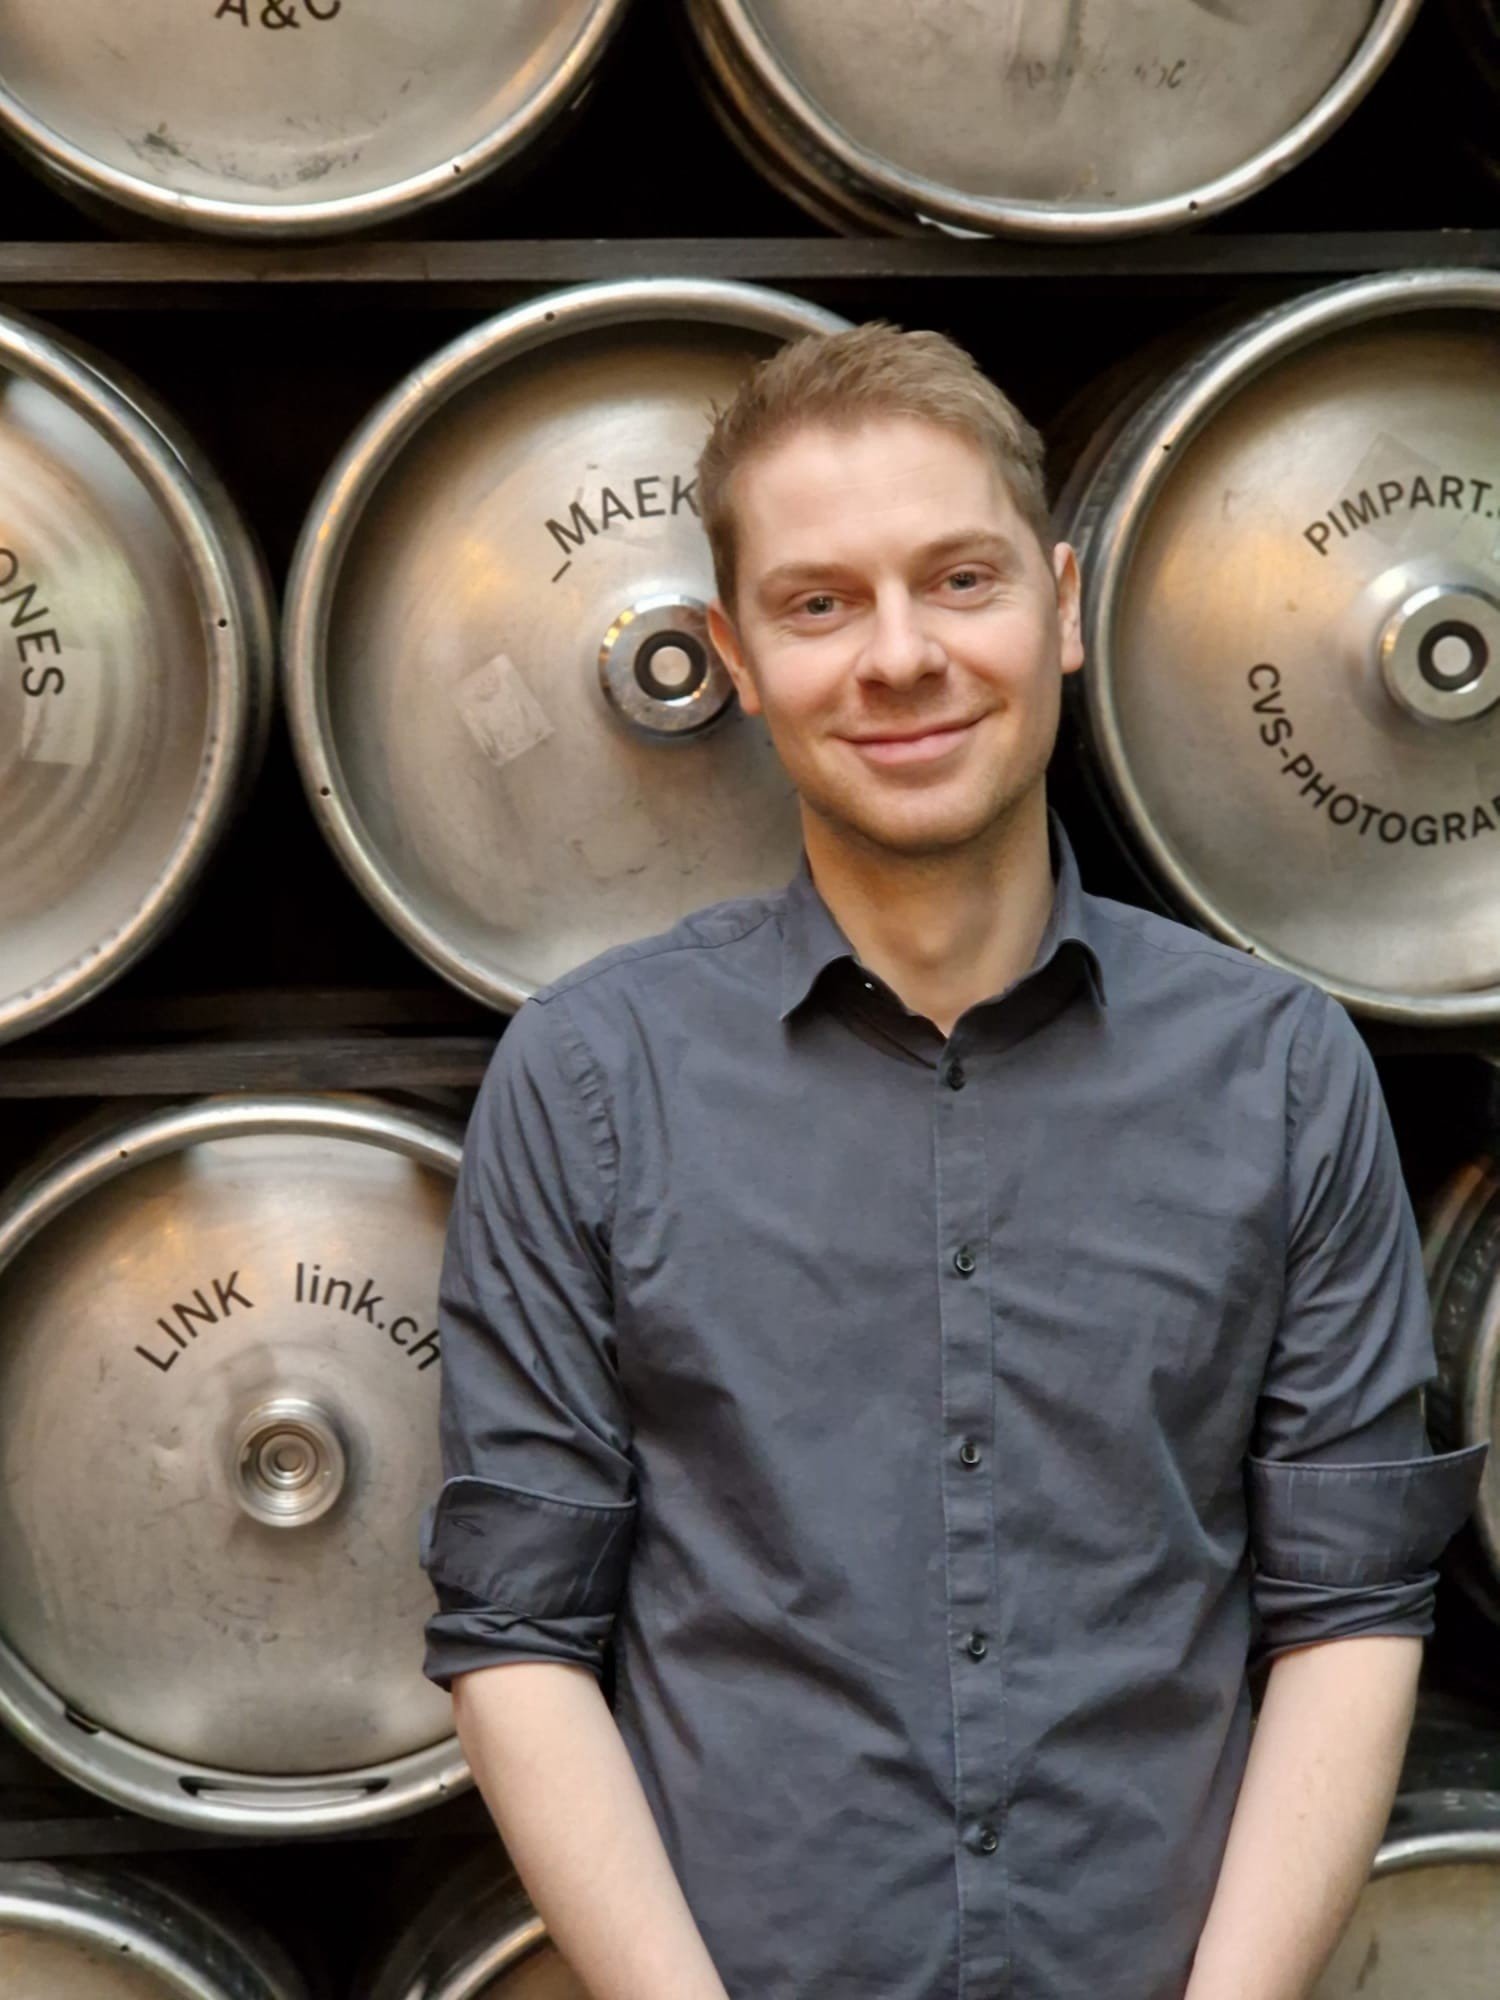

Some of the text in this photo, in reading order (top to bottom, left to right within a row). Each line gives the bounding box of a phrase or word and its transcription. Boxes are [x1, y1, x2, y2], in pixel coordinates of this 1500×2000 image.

[1303, 475, 1500, 556] PIMPART.
[134, 1261, 441, 1373] LINK link.ch
